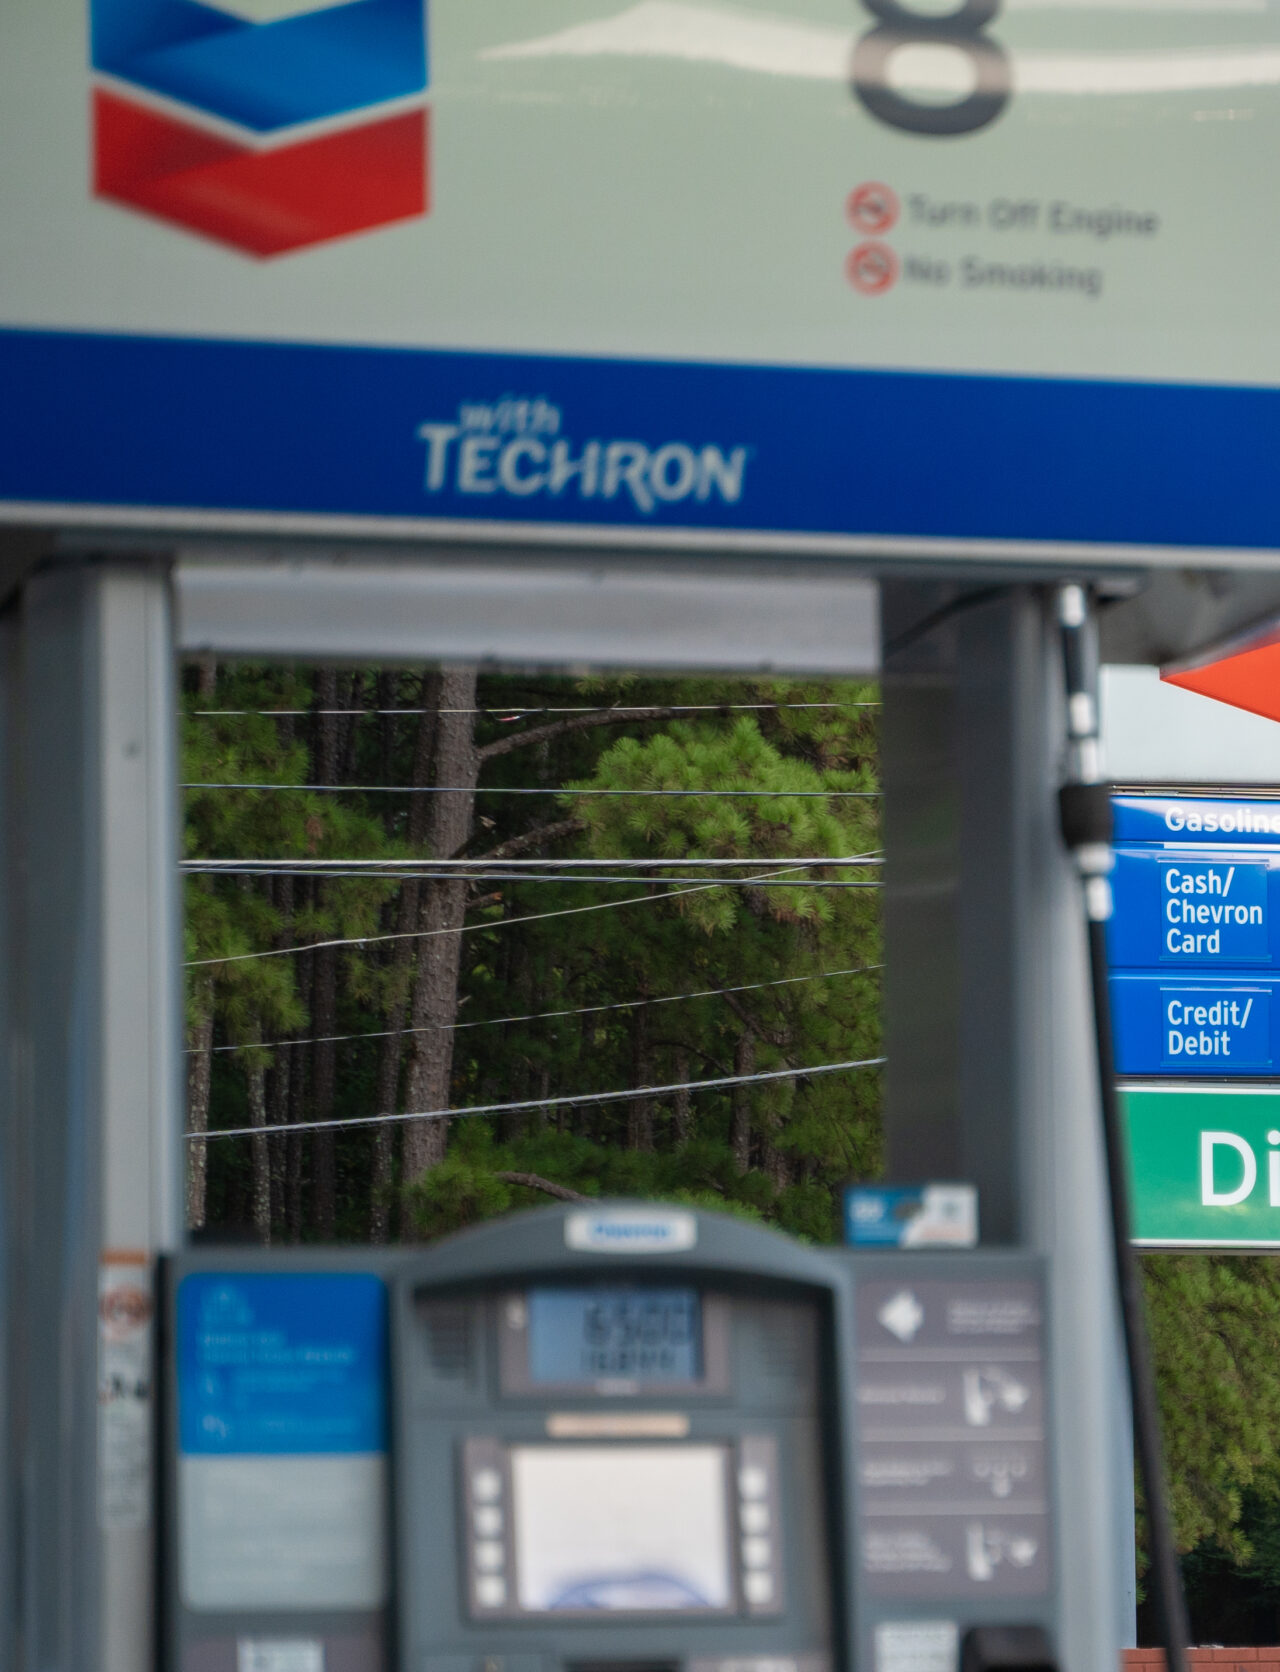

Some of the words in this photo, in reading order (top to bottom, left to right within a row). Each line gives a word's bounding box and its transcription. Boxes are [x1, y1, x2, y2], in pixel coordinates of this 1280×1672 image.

[907, 193, 980, 228] Turn
[988, 198, 1040, 230] Off
[1048, 202, 1159, 240] Engine
[905, 254, 949, 286] No
[960, 255, 1103, 298] Smoking
[459, 394, 562, 434] with
[420, 423, 748, 514] TECHRON
[1165, 866, 1235, 897] Cash/
[1166, 898, 1263, 925] Chevron
[1166, 928, 1220, 954] Card
[1167, 997, 1253, 1029] Credit/
[1168, 1030, 1231, 1056] Debit
